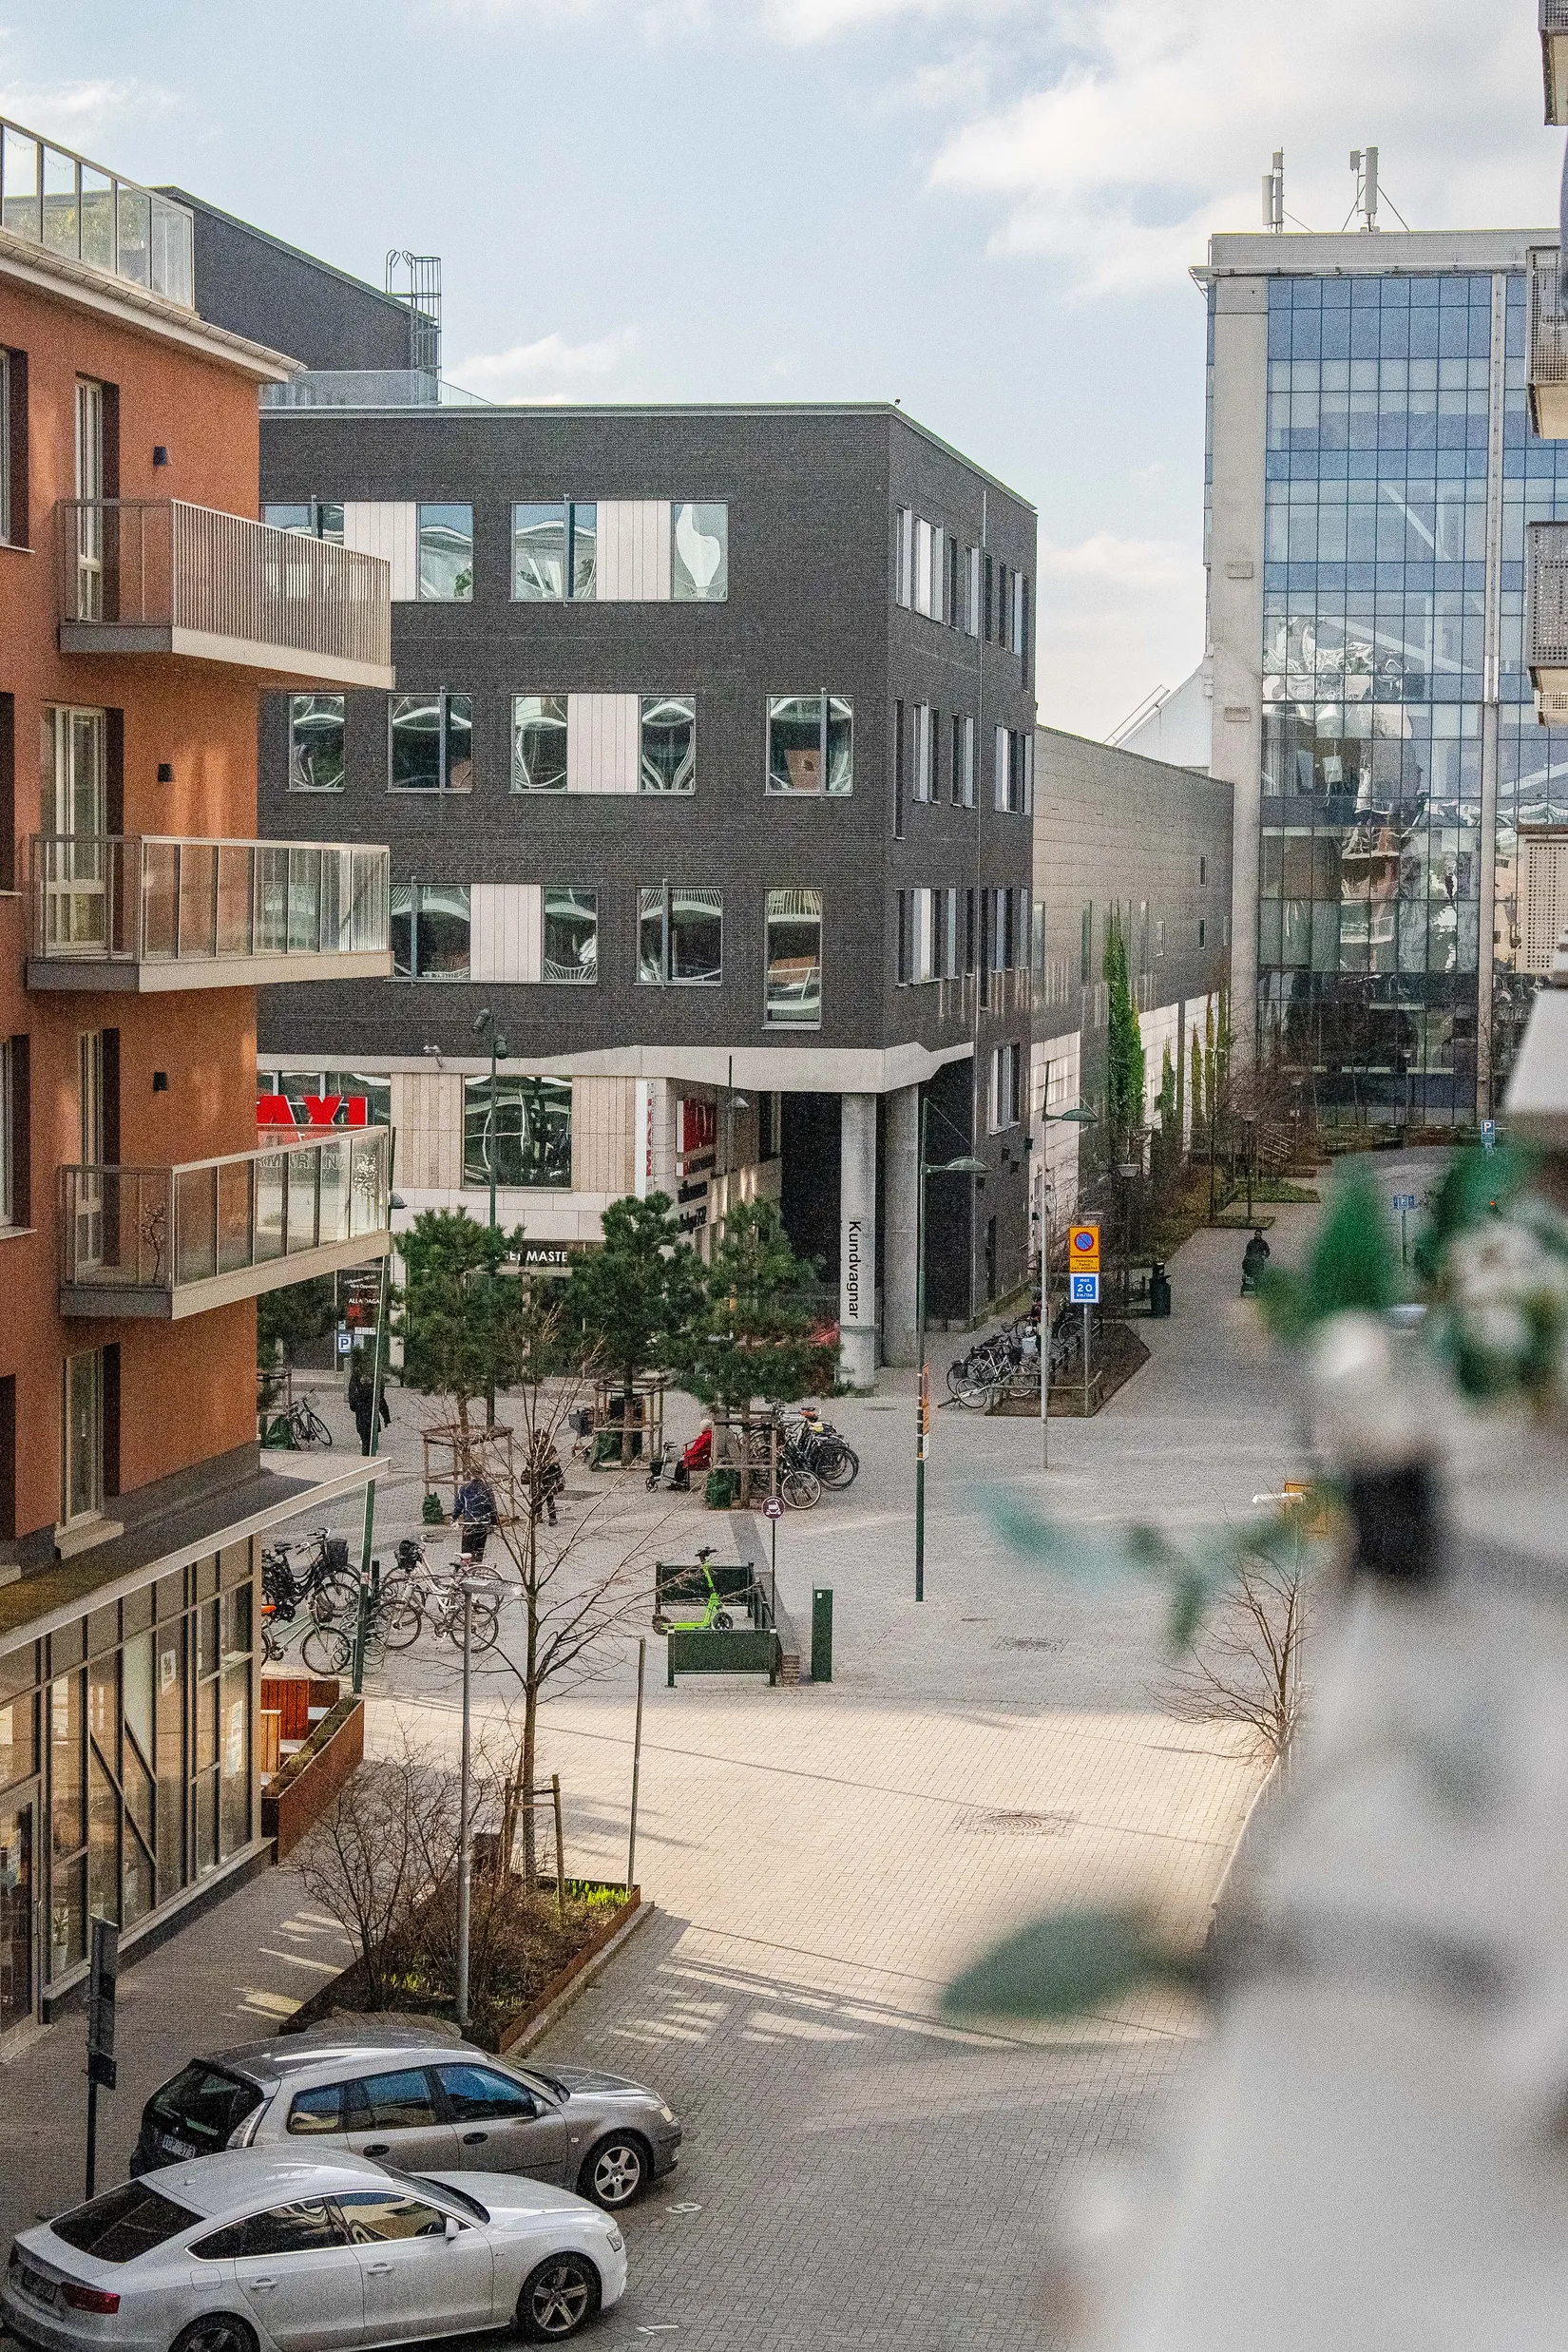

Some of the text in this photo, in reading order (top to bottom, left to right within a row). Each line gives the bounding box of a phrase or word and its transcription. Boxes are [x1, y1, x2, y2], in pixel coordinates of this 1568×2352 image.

[257, 1095, 368, 1146] AXI
[1483, 1122, 1492, 1132] P
[846, 1221, 861, 1319] Kundvagnar
[1077, 1284, 1093, 1292] 20
[340, 1338, 349, 1348] P
